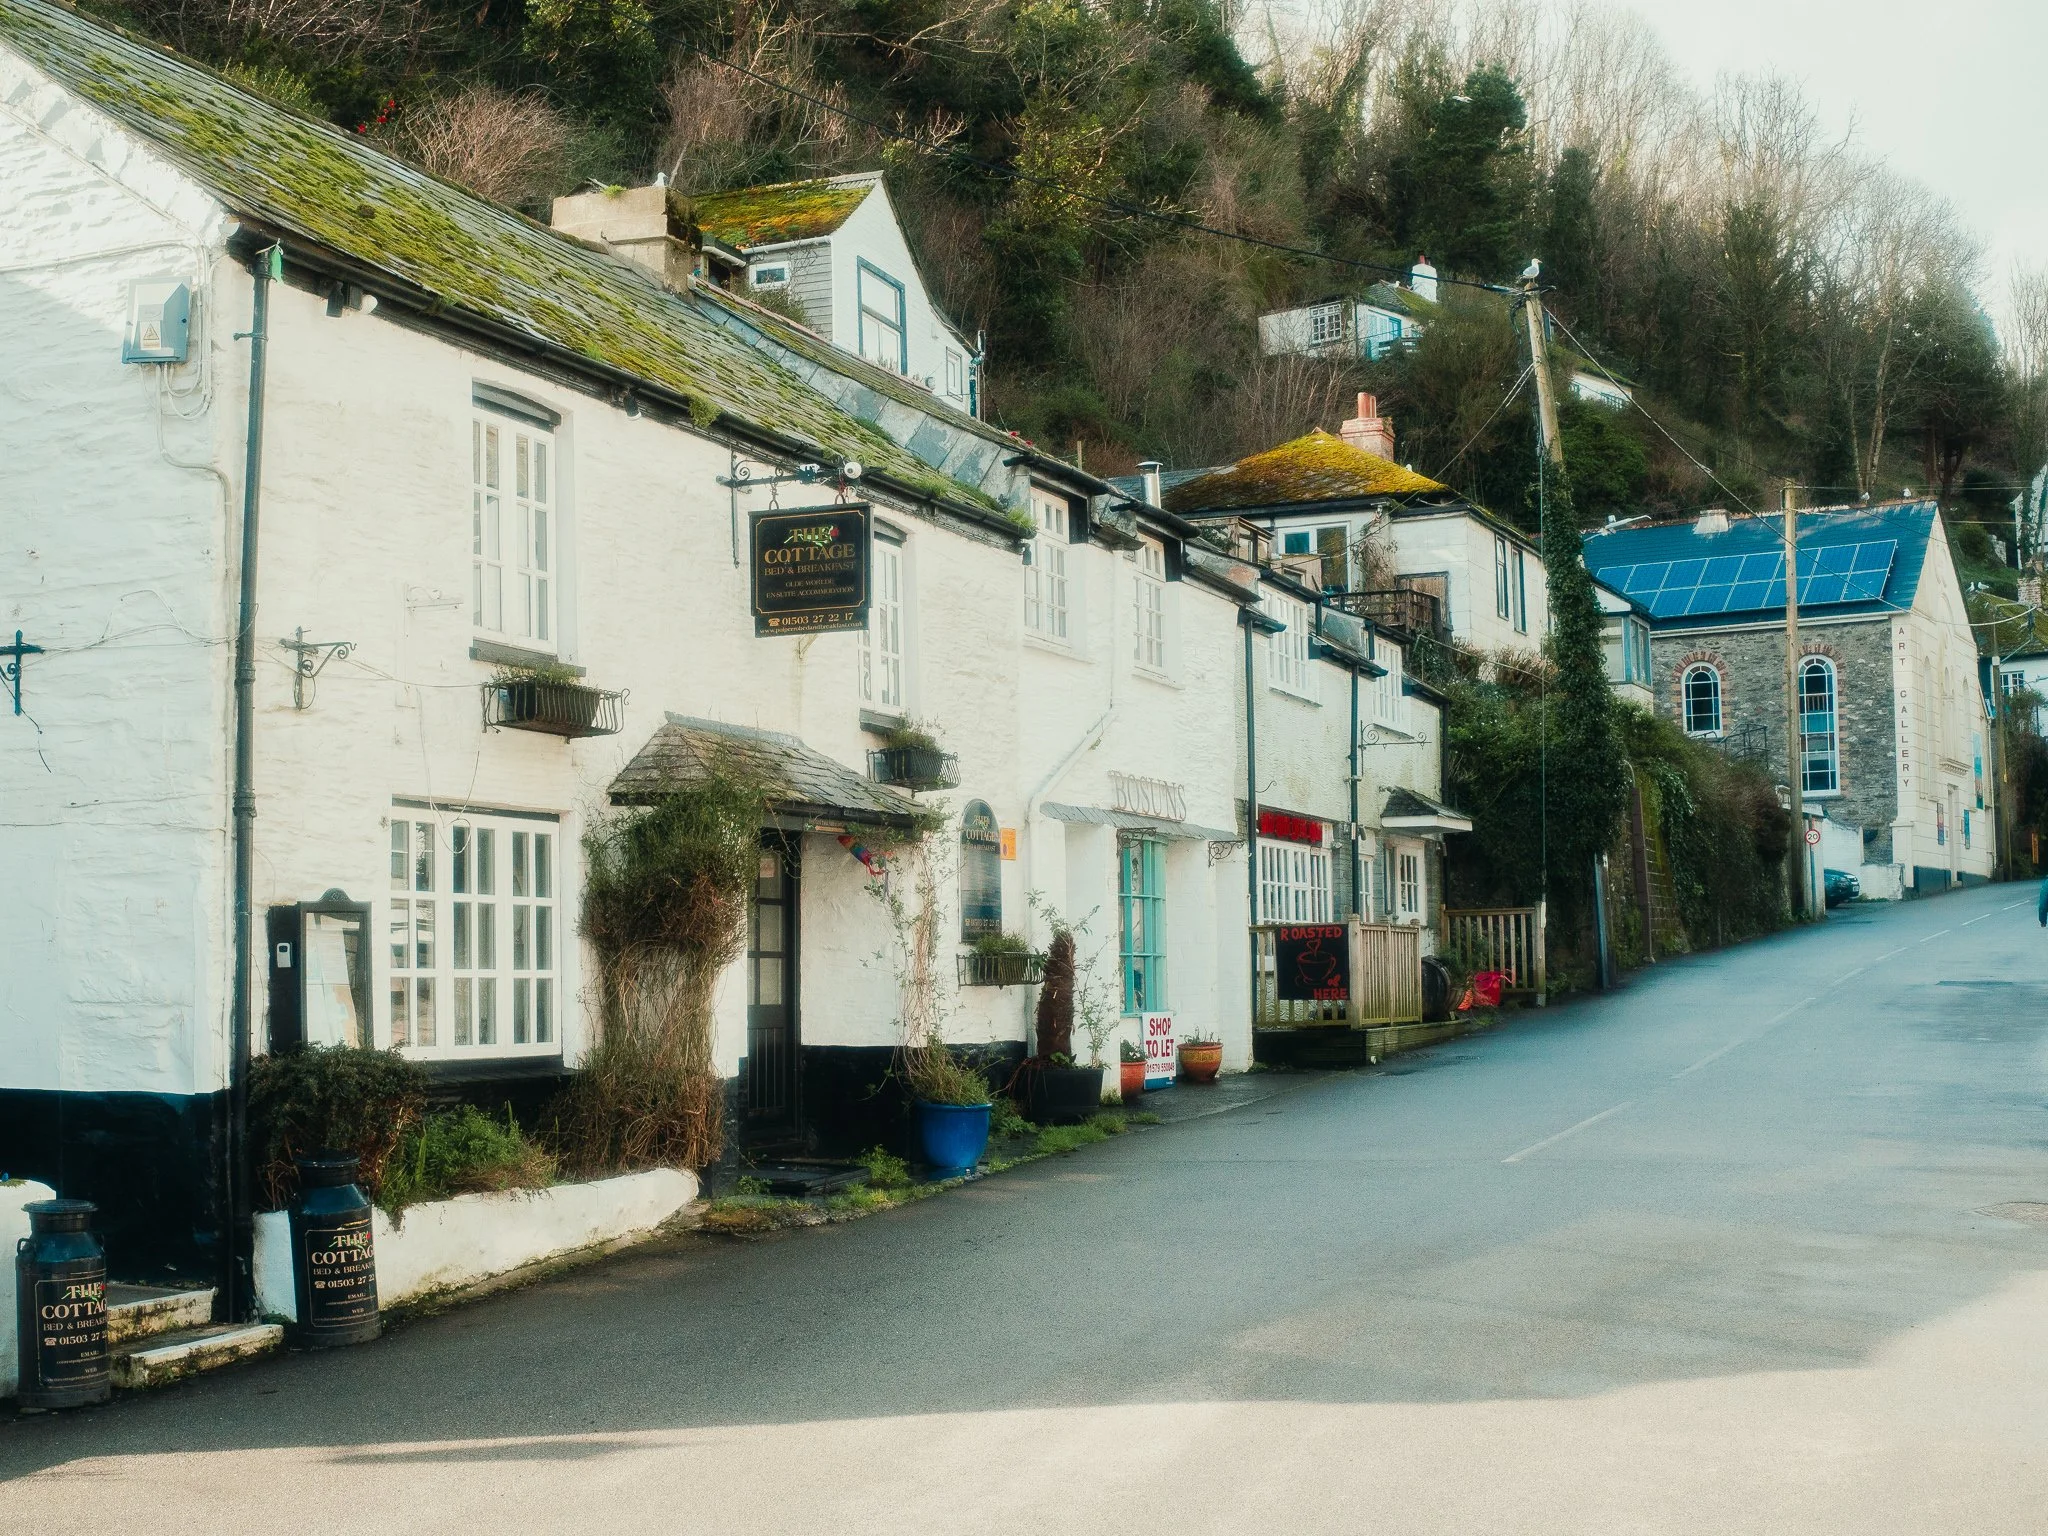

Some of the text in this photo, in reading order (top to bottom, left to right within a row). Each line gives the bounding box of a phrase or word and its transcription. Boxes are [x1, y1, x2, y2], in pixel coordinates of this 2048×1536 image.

[789, 526, 830, 543] THE
[764, 543, 856, 564] COTTAGE
[764, 560, 856, 576] BED & BREAKFAST
[781, 612, 854, 626] 01503 27 22 17
[1898, 627, 1910, 787] ART GALLERY
[1112, 769, 1187, 822] BOSUNS
[966, 829, 997, 842] COTTAGE
[1281, 926, 1343, 941] ROASTED
[1313, 988, 1348, 1000] HERE
[1149, 1017, 1171, 1036] SHOP
[1146, 1038, 1174, 1058] TO LET
[333, 1231, 367, 1247] THE
[328, 1278, 355, 1288] 01503
[357, 1275, 367, 1285] 27
[66, 1282, 102, 1299] THE
[43, 1322, 64, 1331] BED
[66, 1322, 74, 1330] &
[59, 1334, 88, 1345] 01503
[91, 1332, 100, 1342] 27
